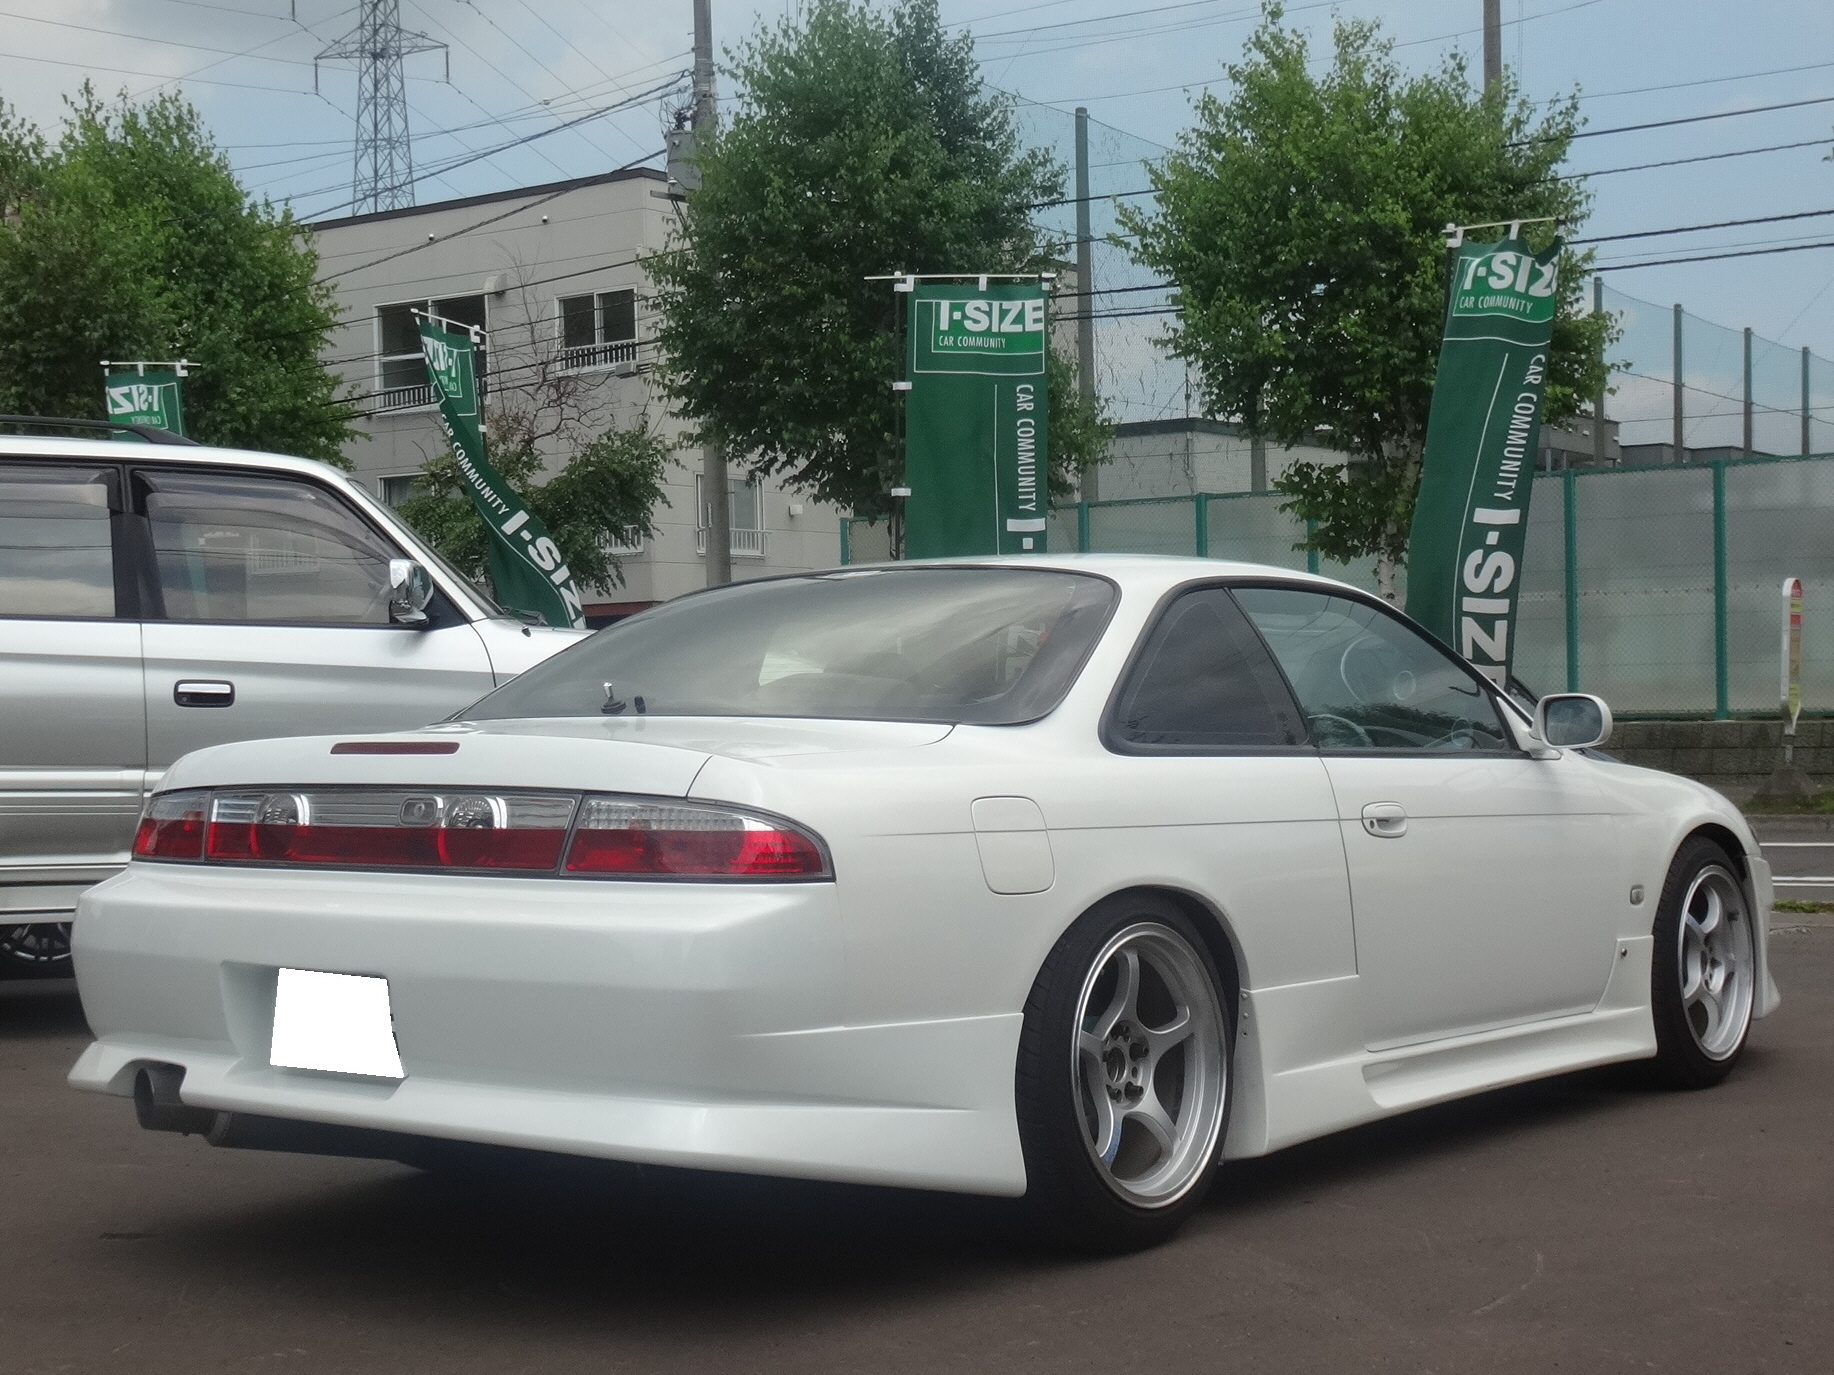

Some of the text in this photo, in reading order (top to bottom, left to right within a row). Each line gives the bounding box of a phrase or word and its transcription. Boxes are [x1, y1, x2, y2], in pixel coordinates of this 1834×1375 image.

[1460, 295, 1533, 314] CAR COMMUNITY
[938, 335, 1006, 349] CAR COMMUNITY
[1016, 384, 1034, 412] CAR
[1494, 354, 1546, 501] CAR COMMUNITY
[453, 441, 510, 515] COMMUNITY
[1016, 418, 1036, 512] COMMUNITY
[501, 509, 587, 630] I-SIZ
